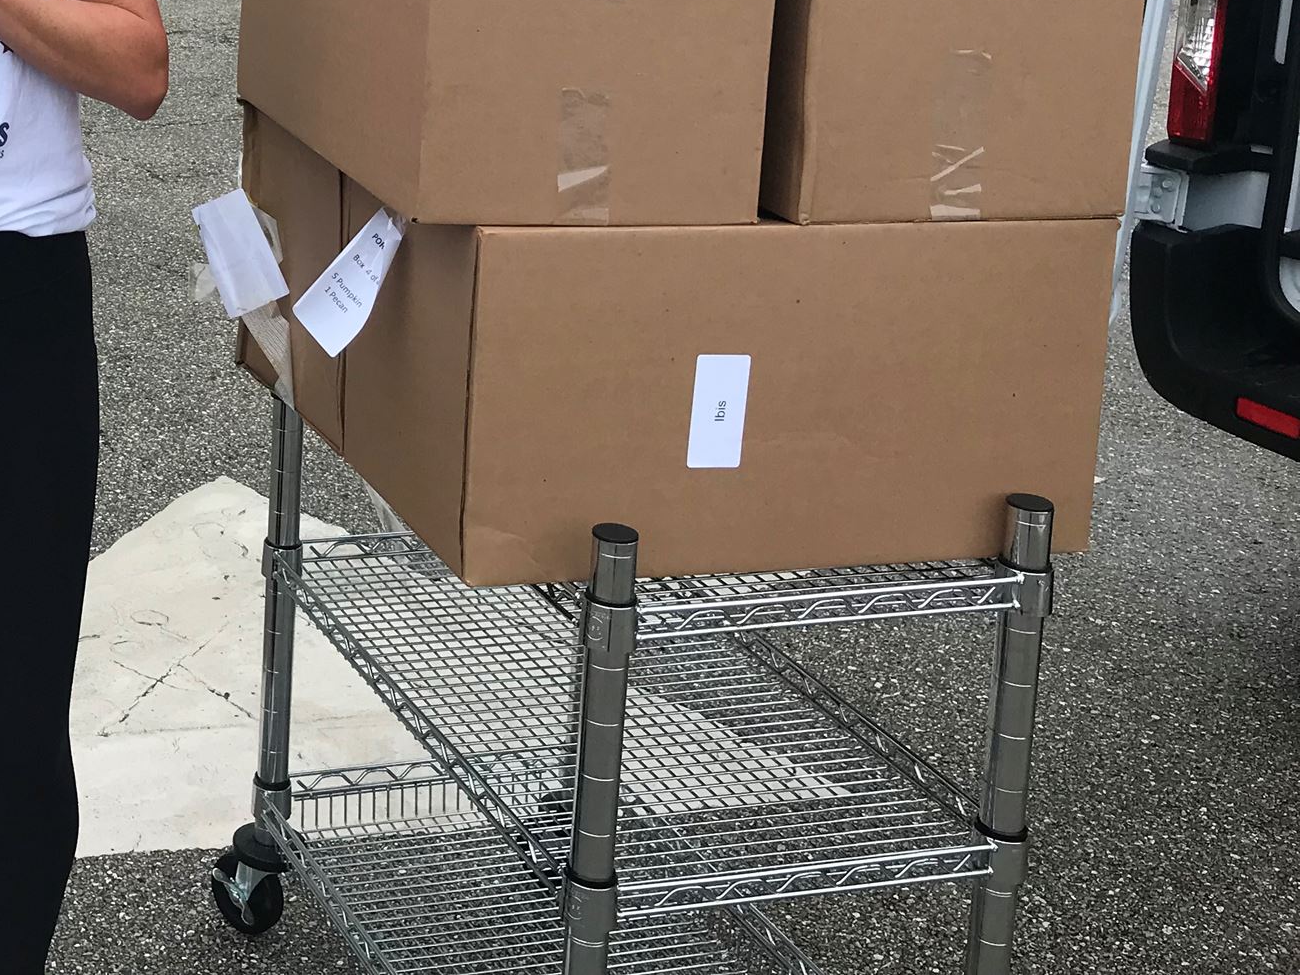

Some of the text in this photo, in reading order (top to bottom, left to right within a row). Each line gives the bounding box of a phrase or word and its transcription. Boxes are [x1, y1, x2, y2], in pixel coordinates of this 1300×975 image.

[353, 254, 365, 268] Box
[329, 291, 349, 314] Pecan
[337, 278, 363, 308] Pumpkin
